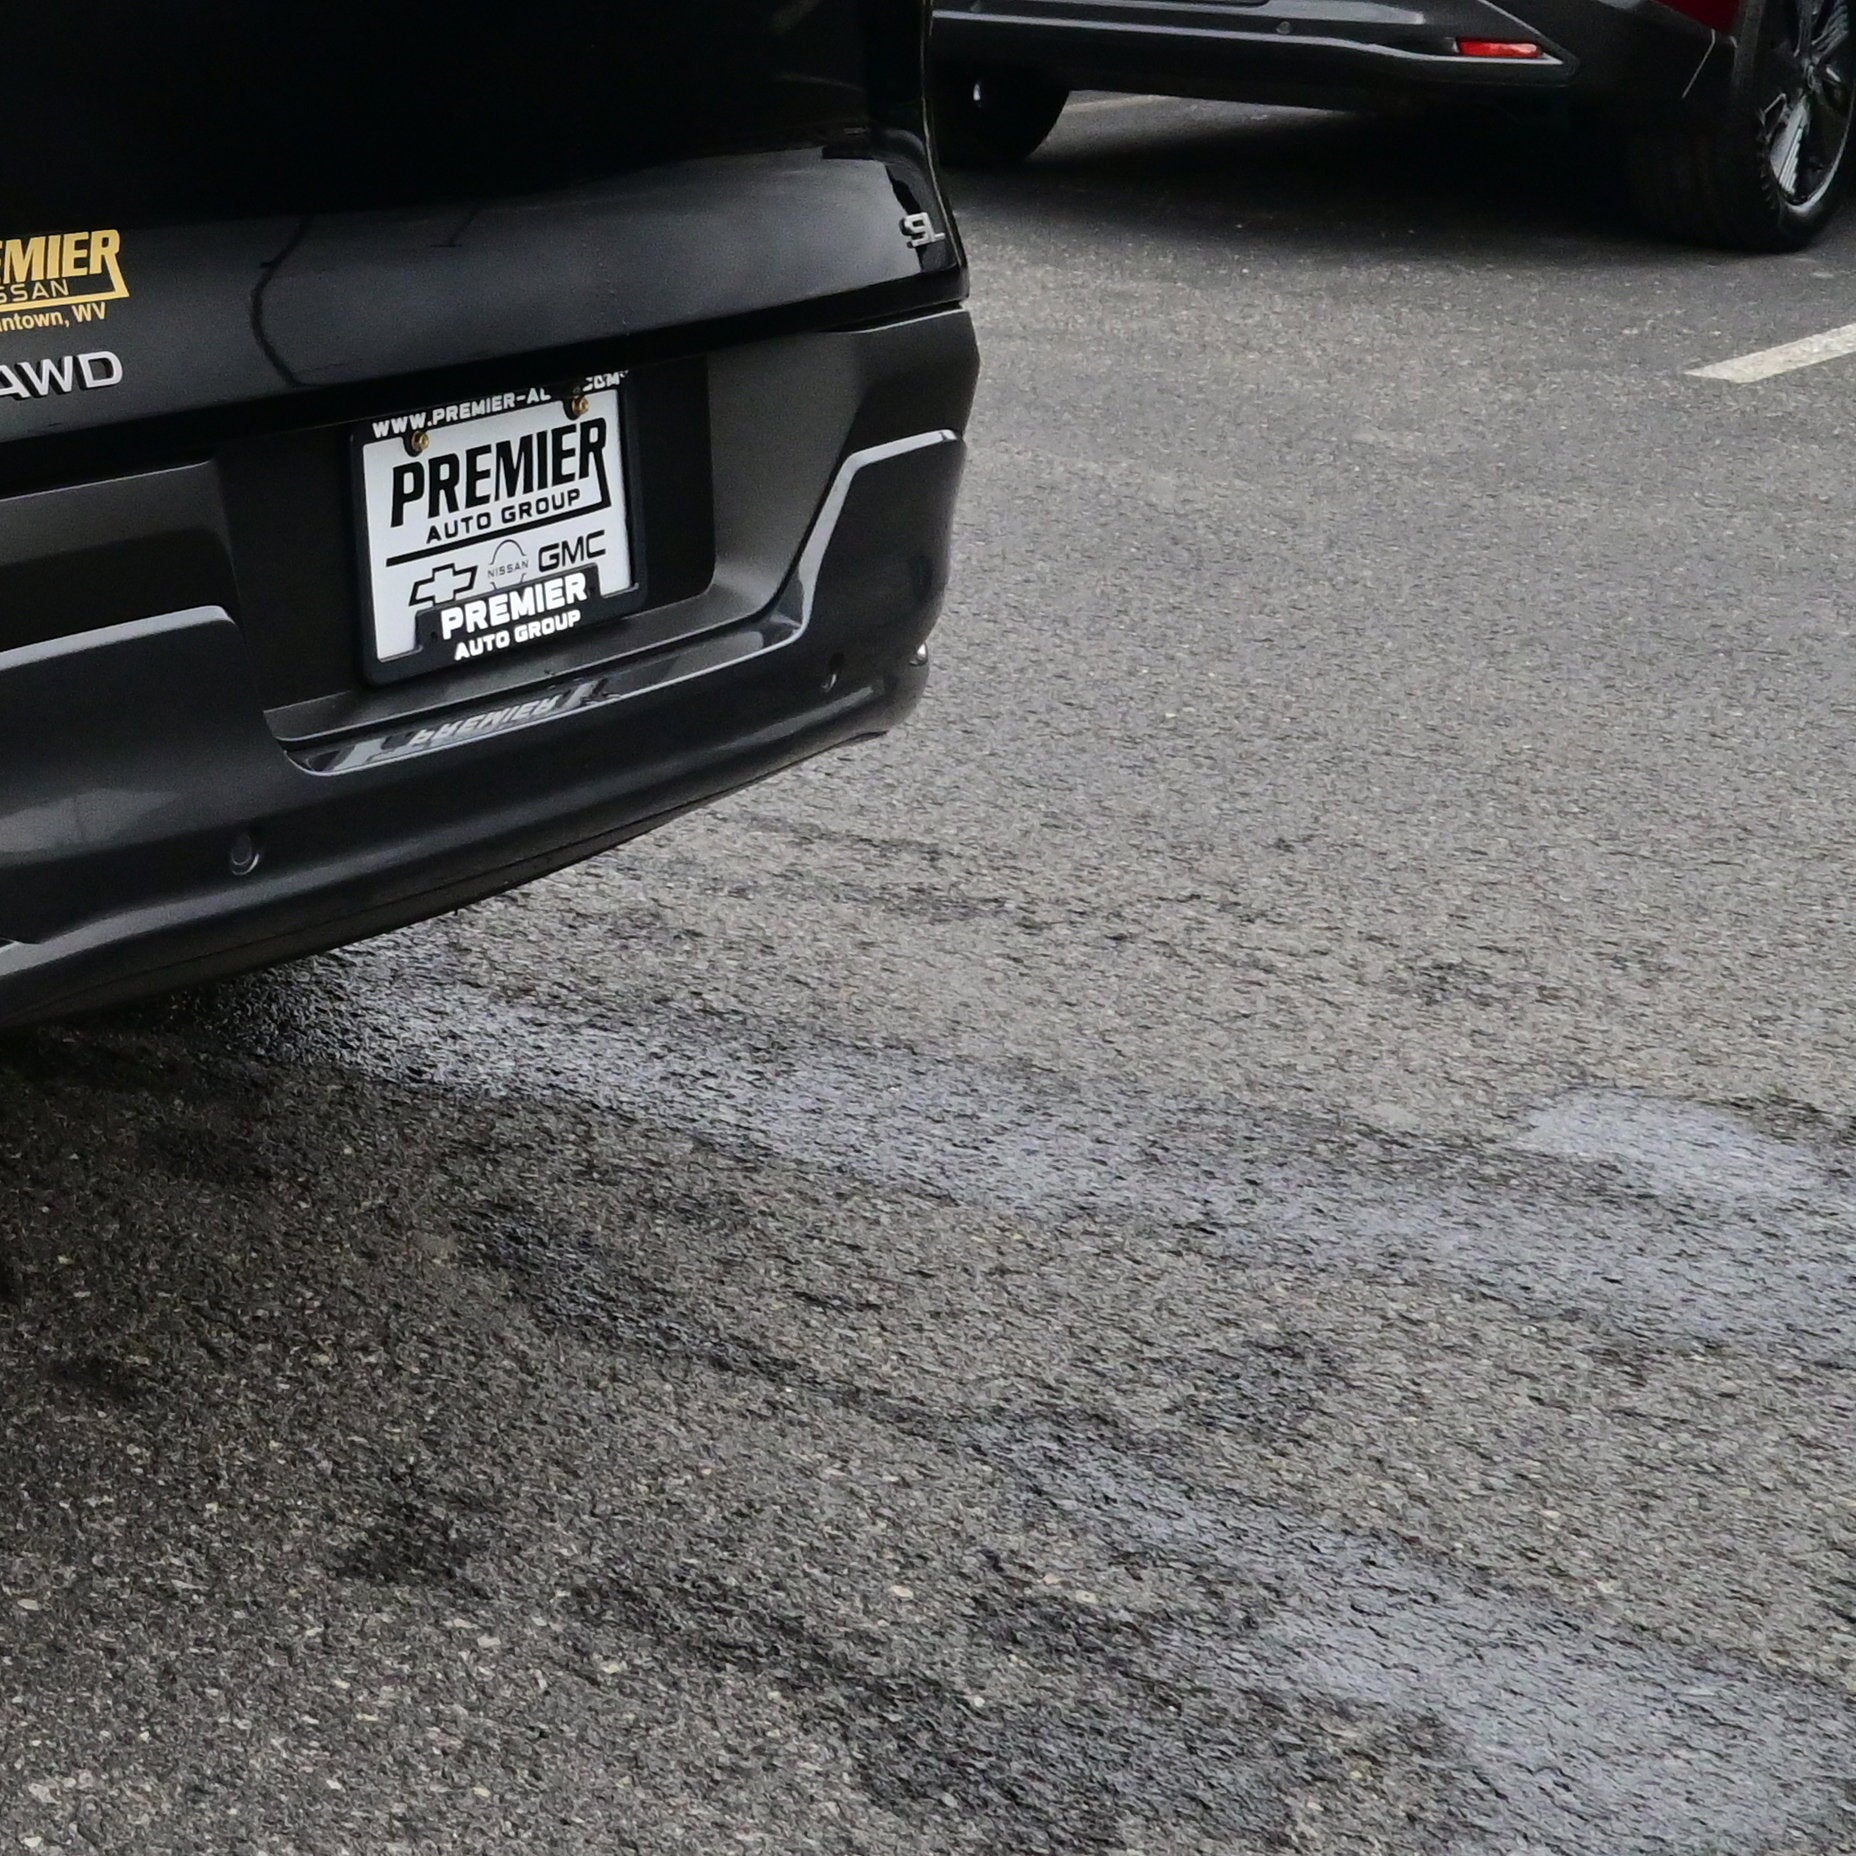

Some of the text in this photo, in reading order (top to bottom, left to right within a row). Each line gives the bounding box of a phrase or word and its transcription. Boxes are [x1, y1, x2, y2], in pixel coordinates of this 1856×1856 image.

[71, 302, 106, 323] WV
[390, 417, 611, 528] PREMIER
[426, 488, 581, 544] AUTO GROUP
[487, 530, 606, 578] NISSAN GMC
[441, 572, 587, 640] PREMIER
[454, 609, 581, 661] AUTO GROUP
